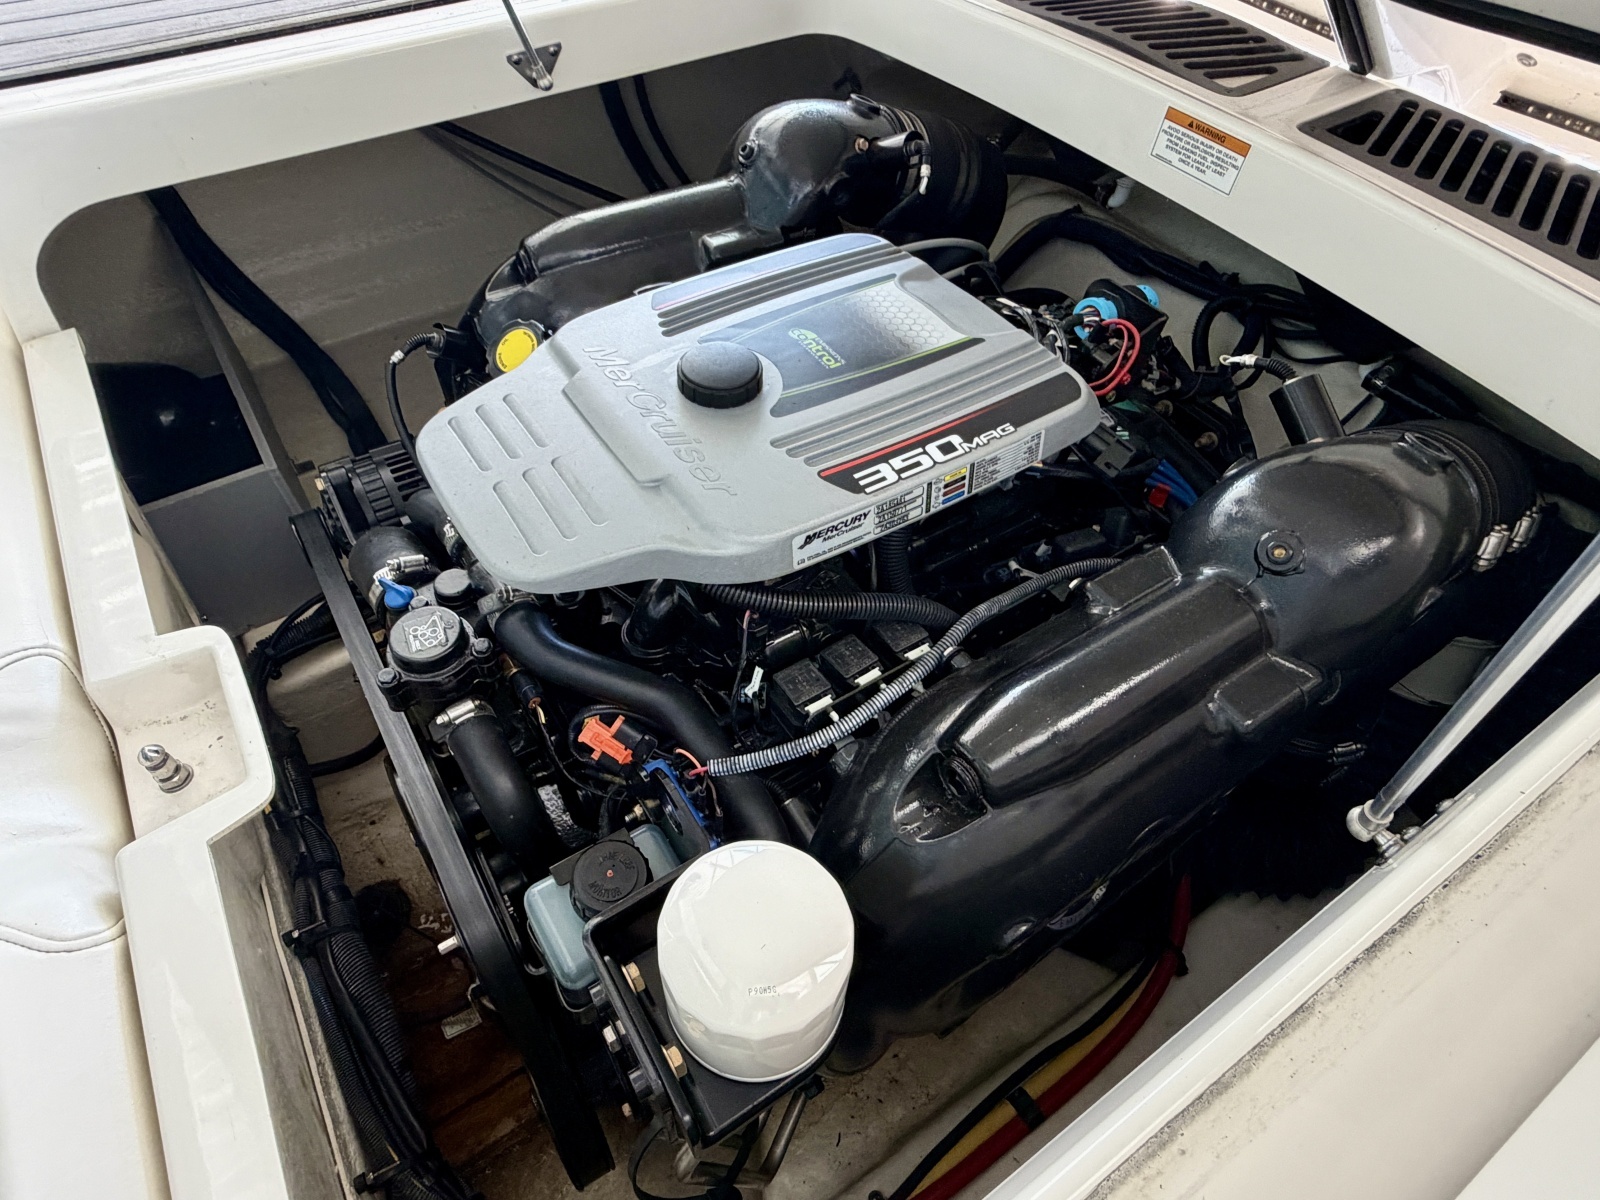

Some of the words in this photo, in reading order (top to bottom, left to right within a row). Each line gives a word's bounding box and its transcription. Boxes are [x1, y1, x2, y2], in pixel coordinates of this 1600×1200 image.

[1161, 129, 1174, 137] FROM
[1191, 143, 1215, 158] EXPLOSION
[1215, 156, 1240, 170] RESULTING
[1168, 125, 1181, 134] AVOID
[1181, 132, 1200, 143] SERIOUS
[1200, 141, 1216, 151] INJURY
[1223, 153, 1238, 162] DEATH
[1195, 123, 1226, 144] WARNING
[1165, 144, 1182, 155] SYSTEM
[1182, 152, 1191, 160] FOR
[1191, 157, 1205, 167] LEAKS
[1212, 169, 1226, 177] LEAST
[1166, 138, 1179, 146] FROM
[1179, 144, 1198, 156] LEAKING
[1210, 161, 1229, 172] INSPECT
[1178, 158, 1191, 167] ONCE
[583, 347, 738, 497] MerCruiser
[853, 434, 965, 494] 350
[962, 423, 1016, 454] MAG
[797, 509, 872, 550] MERCURY
[821, 521, 865, 543] MerCruiser
